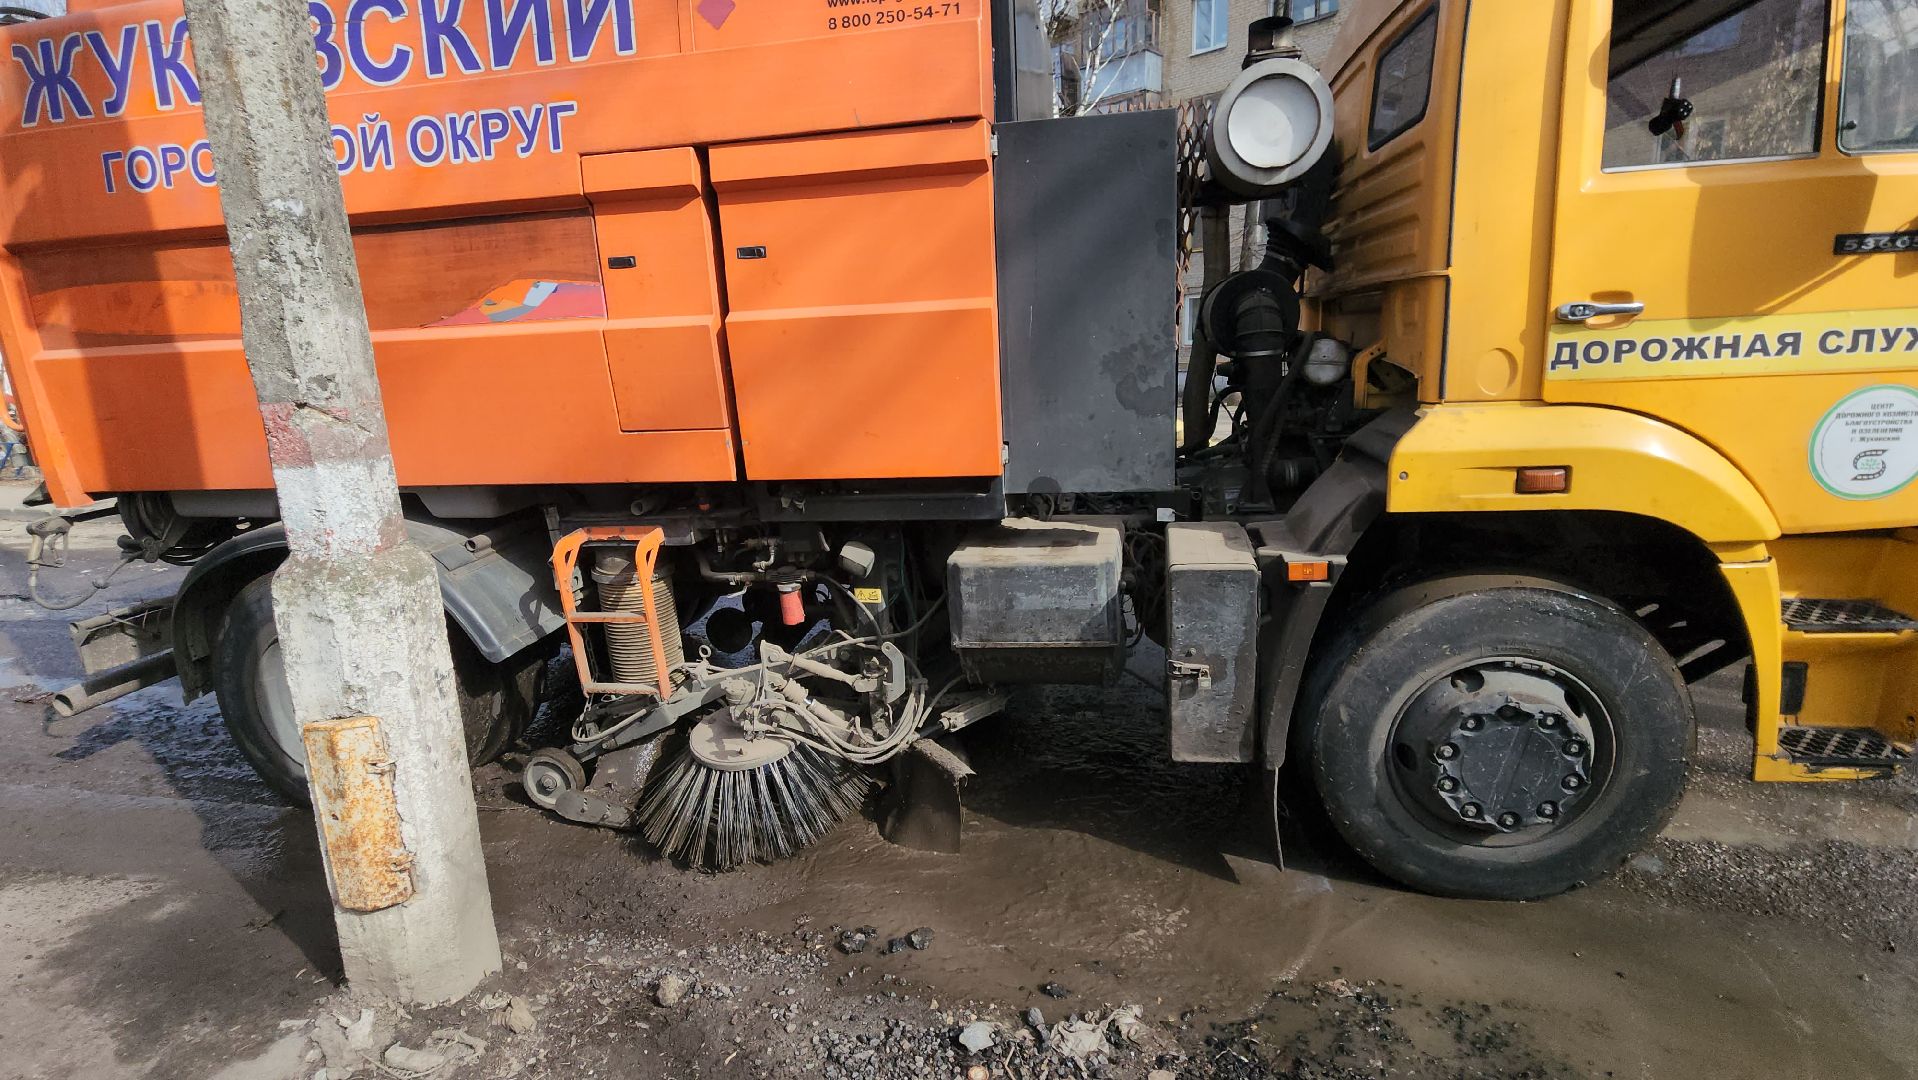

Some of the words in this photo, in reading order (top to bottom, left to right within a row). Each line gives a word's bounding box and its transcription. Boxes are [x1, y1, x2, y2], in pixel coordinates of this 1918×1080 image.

[828, 17, 837, 30] 8
[842, 13, 871, 28] 800
[876, 2, 960, 25] 250-54-71
[11, 0, 638, 126] ЖУКВСКИЙ
[101, 112, 394, 193] ГОРООЙ
[407, 101, 577, 167] ОКРУГ
[1551, 332, 1801, 370] ДОРОЖНАЯ
